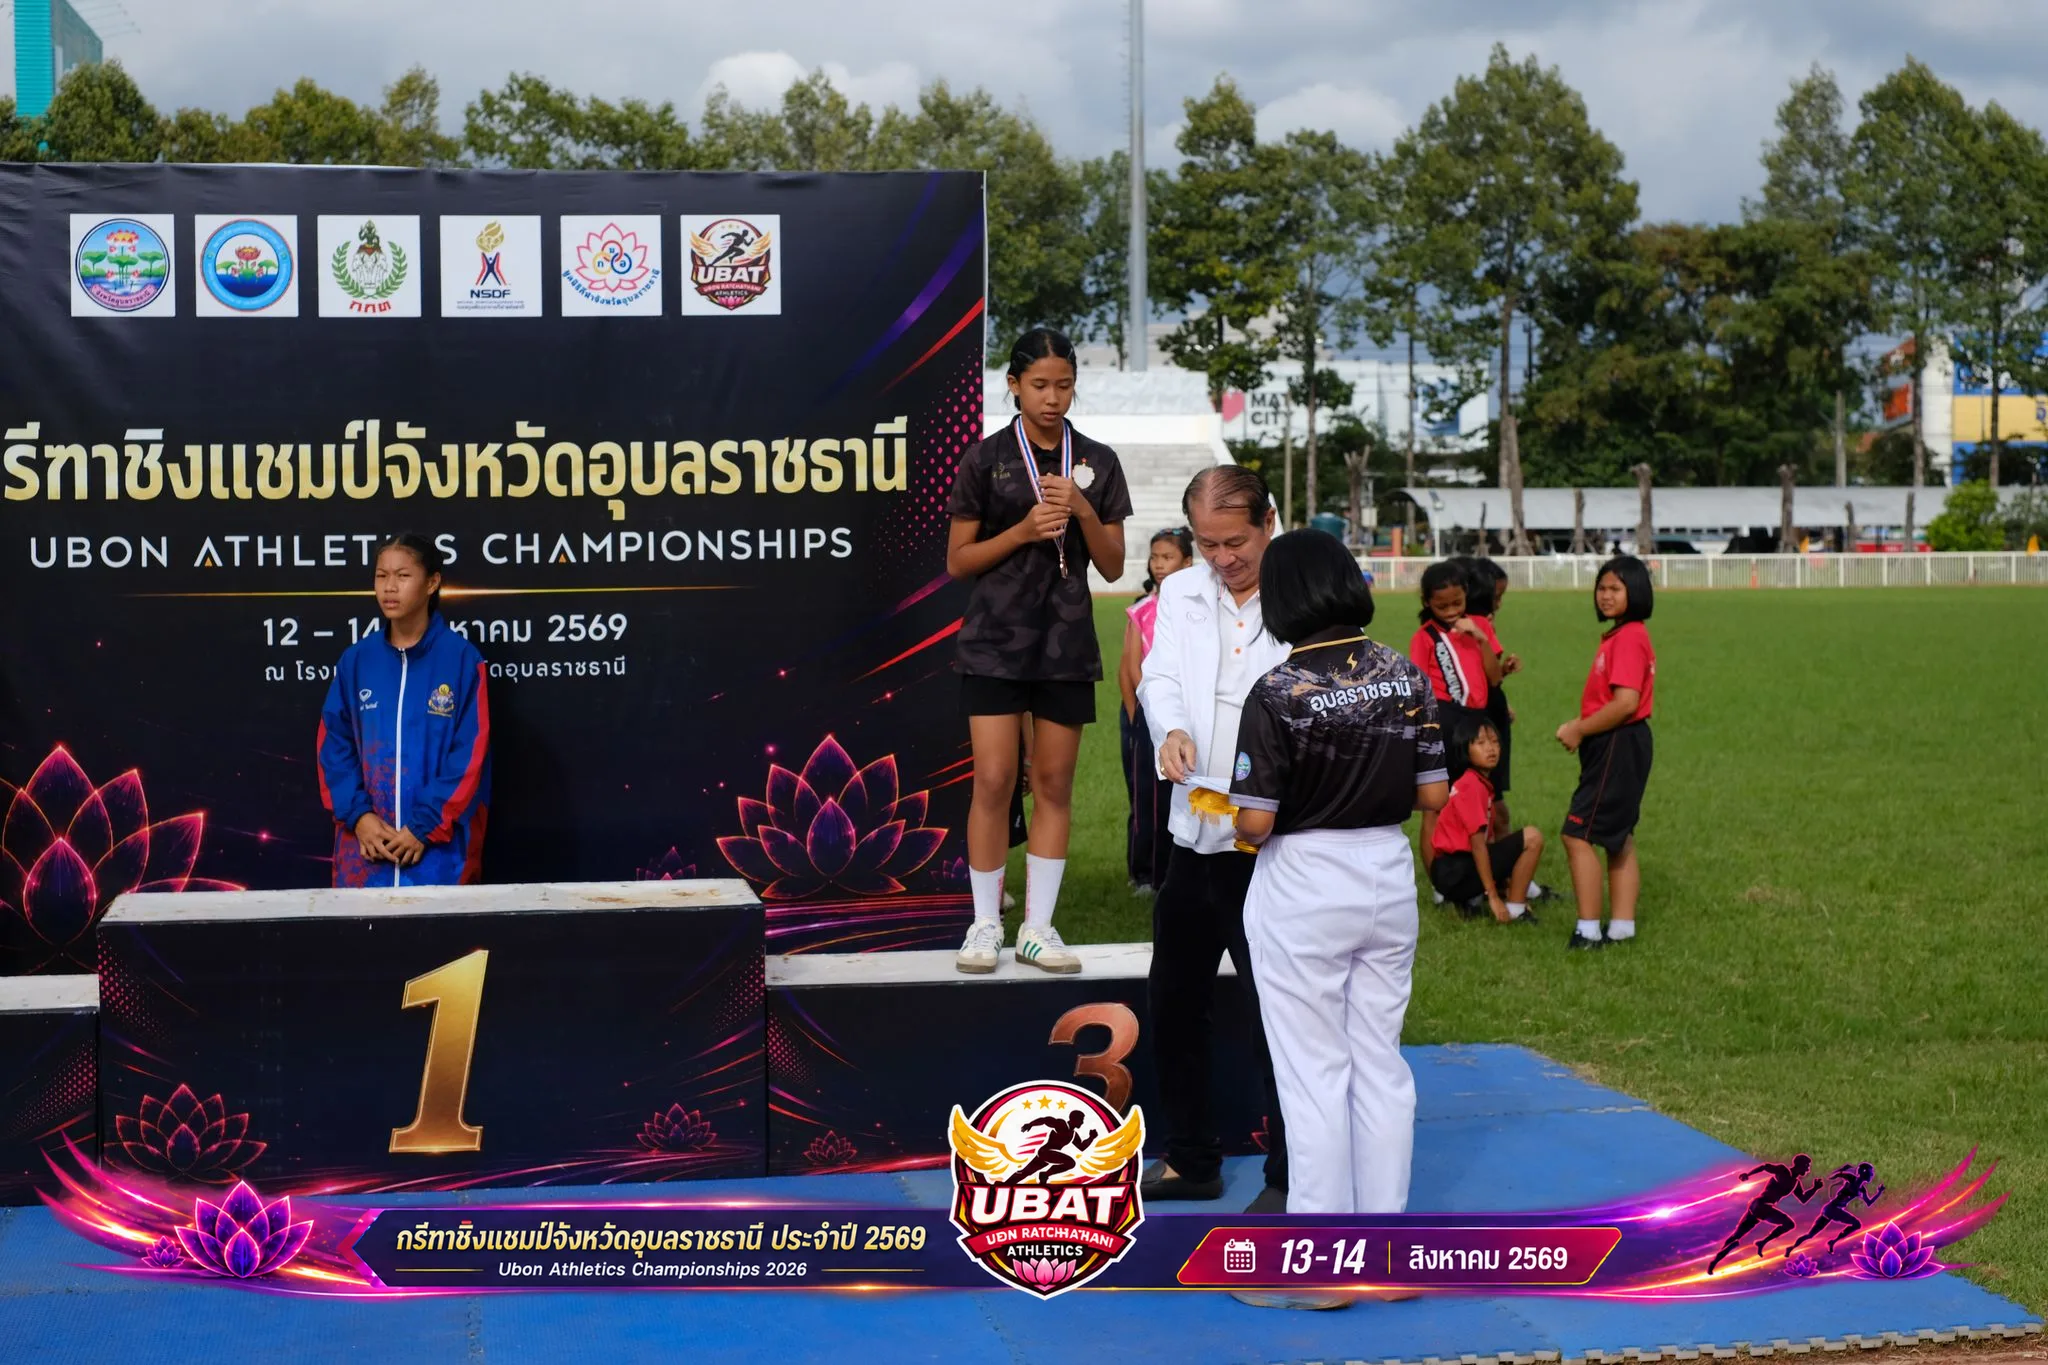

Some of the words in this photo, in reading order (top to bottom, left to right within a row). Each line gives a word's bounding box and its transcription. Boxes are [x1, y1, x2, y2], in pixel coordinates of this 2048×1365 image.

[697, 266, 766, 284] UBAT
[470, 289, 511, 299] NSDF
[30, 536, 168, 569] UBON
[194, 533, 457, 568] ATHLETS
[482, 527, 853, 565] CHAMPIONSHIPS
[263, 617, 299, 646] 12
[547, 613, 628, 642] 2569
[265, 666, 285, 681] ณ
[1310, 675, 1412, 718] อุบลราชธานี
[388, 948, 489, 1154] 1
[1048, 1001, 1140, 1114] 3
